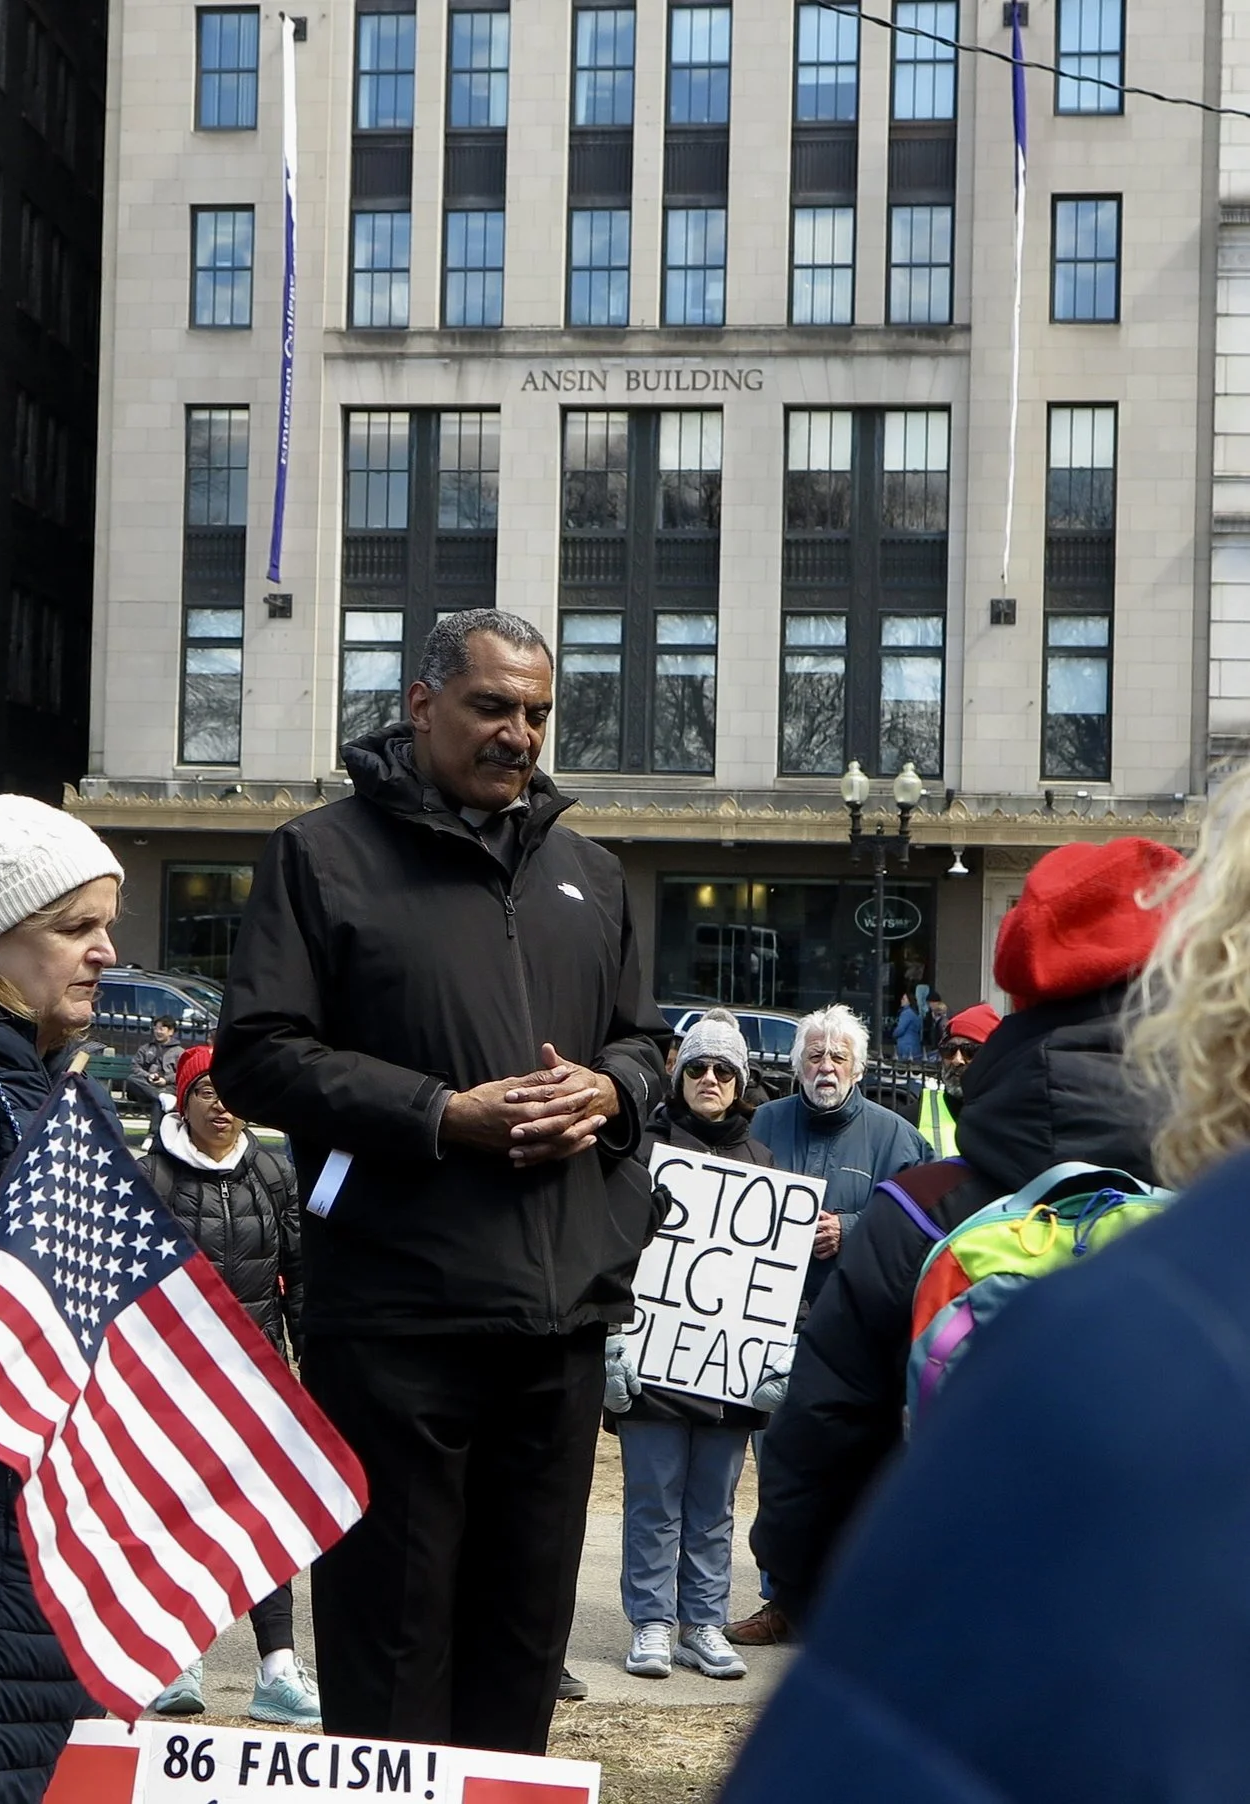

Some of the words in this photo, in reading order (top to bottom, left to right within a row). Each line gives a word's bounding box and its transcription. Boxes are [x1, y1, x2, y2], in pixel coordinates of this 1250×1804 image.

[521, 369, 609, 391] ANSIN
[625, 368, 764, 391] BUILDING
[654, 1159, 819, 1251] STOP
[638, 1233, 798, 1328] ICE
[163, 1734, 216, 1783] 86
[238, 1741, 437, 1800] FACISM!
